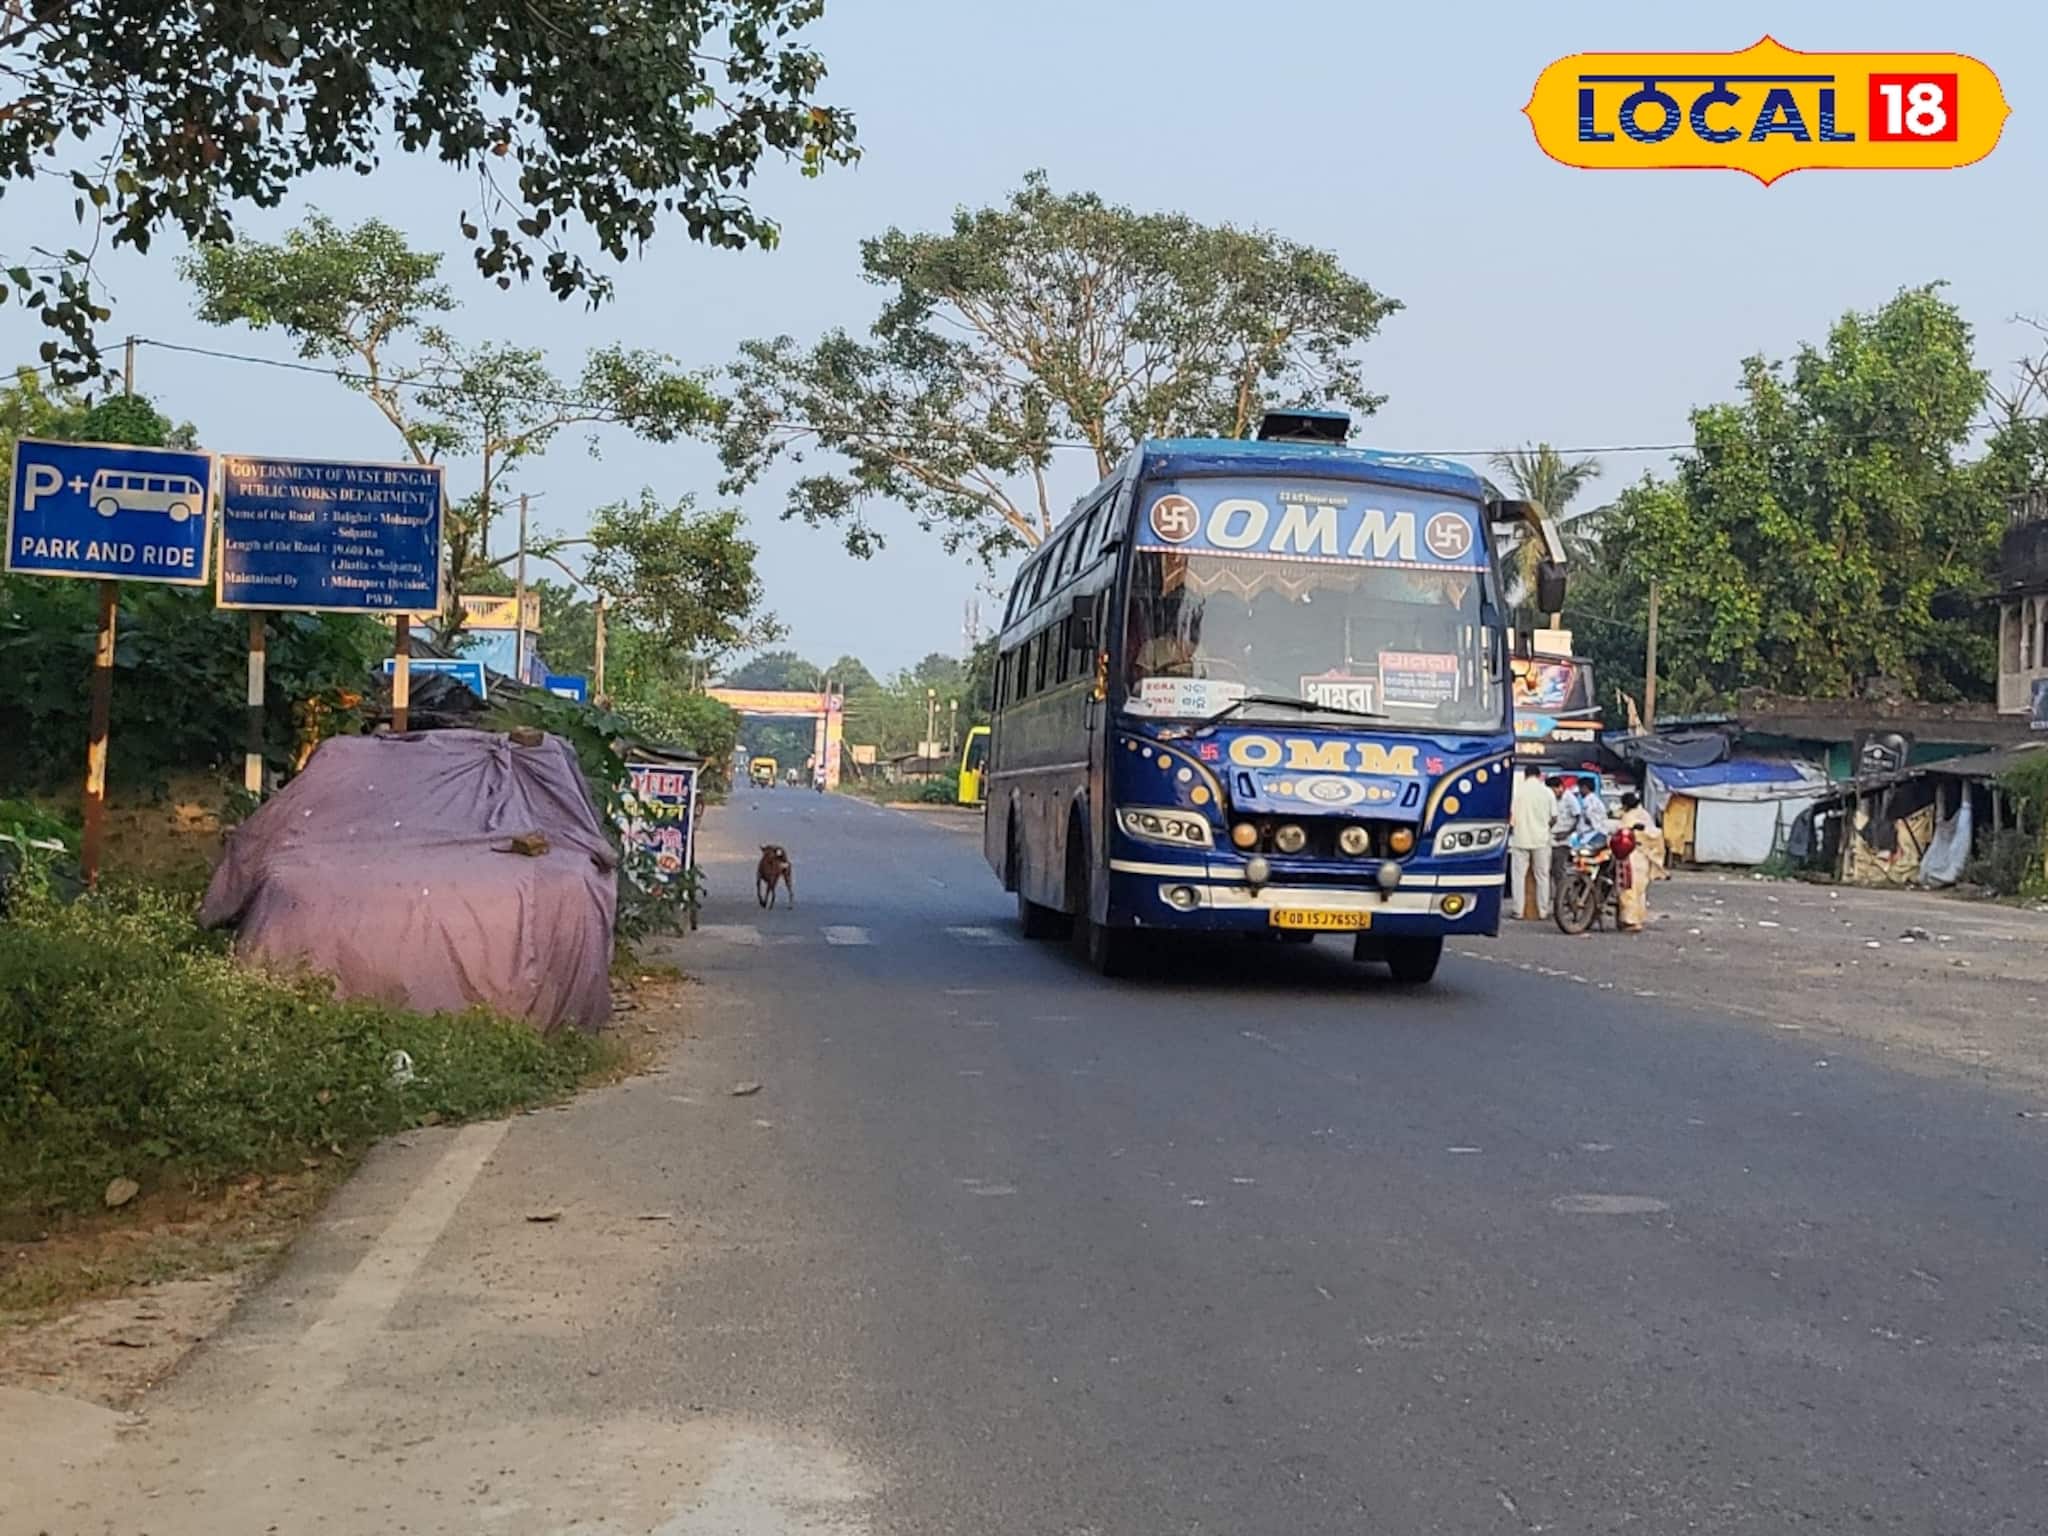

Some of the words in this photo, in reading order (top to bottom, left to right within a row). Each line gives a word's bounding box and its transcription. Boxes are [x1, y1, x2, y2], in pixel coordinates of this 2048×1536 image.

[231, 463, 322, 480] GOVERNMENT
[325, 468, 343, 481] OF
[345, 470, 379, 484] WEST
[384, 471, 436, 486] BENGAL
[240, 483, 288, 497] PUBLIC
[290, 486, 337, 500] WORKS
[340, 488, 424, 505] DEPARTMENT
[226, 507, 255, 520] Name
[271, 508, 286, 521] the
[289, 510, 315, 522] Road
[1206, 498, 1416, 561] OMM
[21, 536, 80, 559] PARK
[85, 541, 135, 563] AND
[143, 545, 195, 568] RIDE
[294, 541, 320, 553] Road
[225, 571, 282, 585] Maintained
[1229, 735, 1419, 776] OMM
